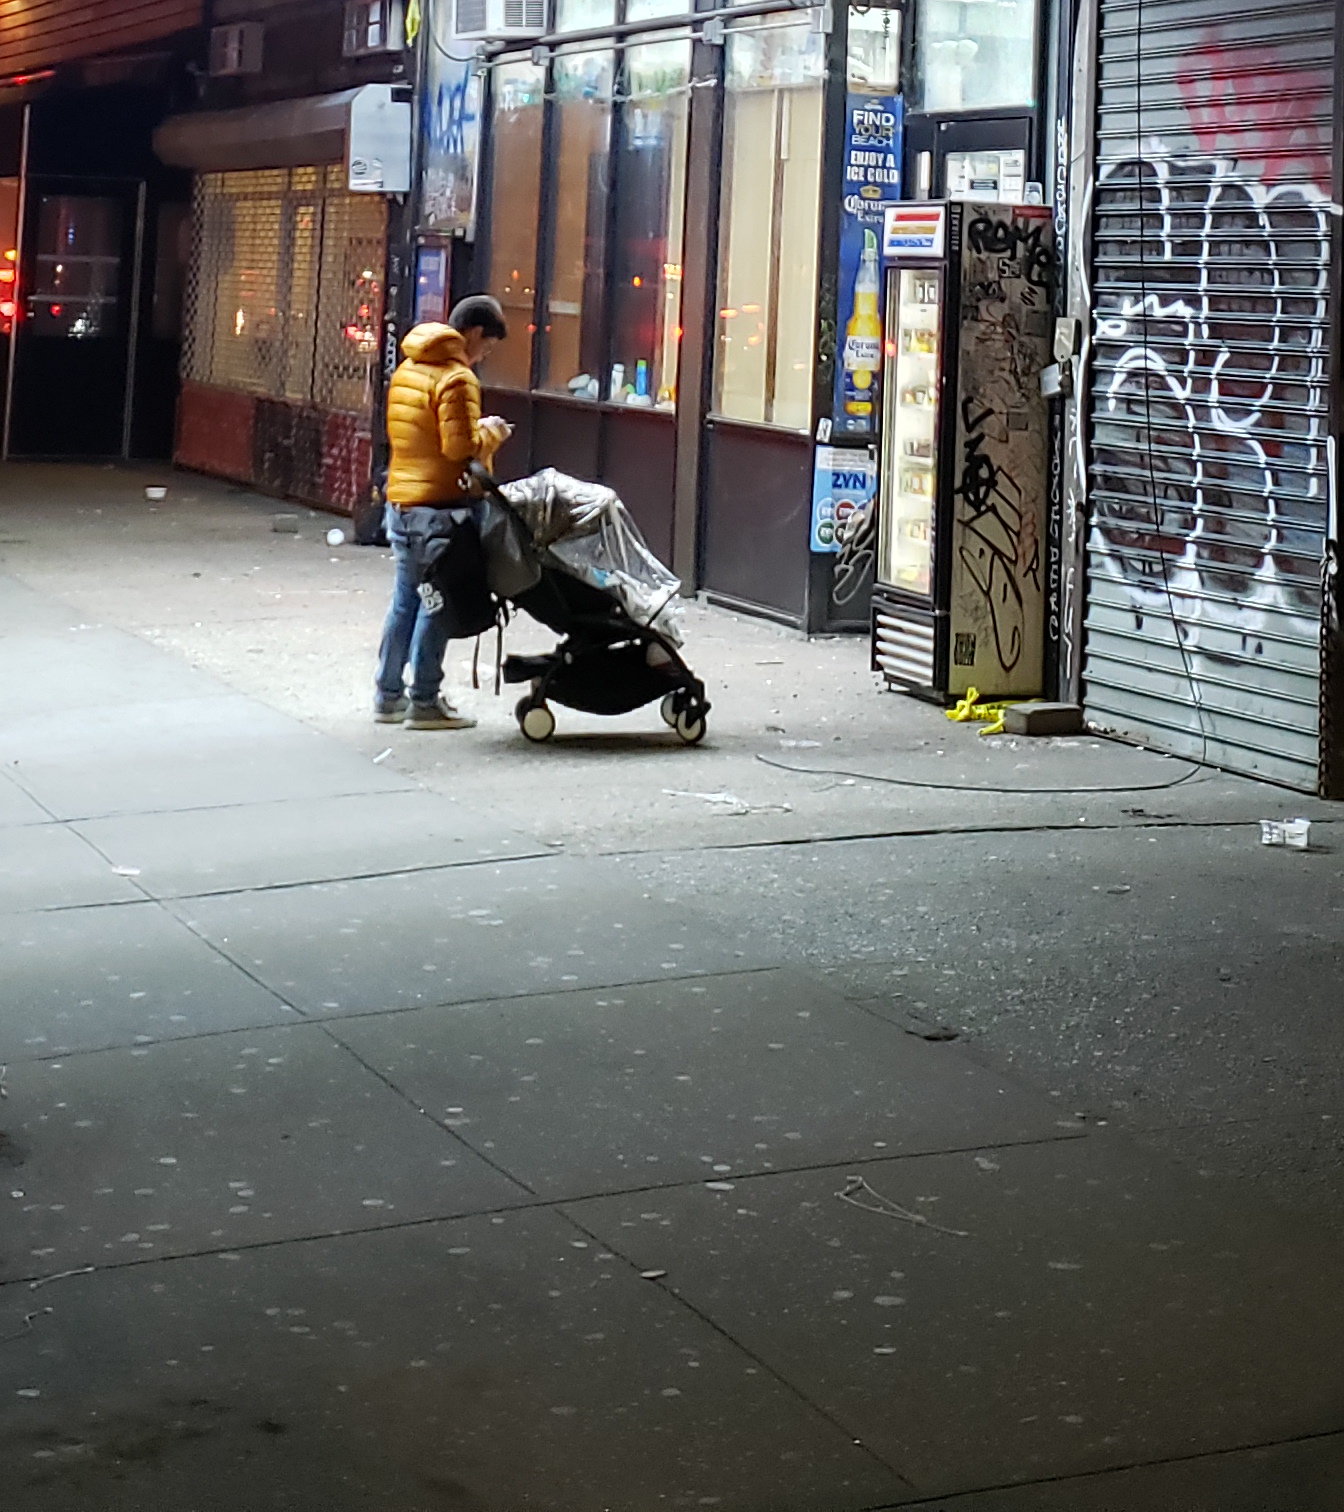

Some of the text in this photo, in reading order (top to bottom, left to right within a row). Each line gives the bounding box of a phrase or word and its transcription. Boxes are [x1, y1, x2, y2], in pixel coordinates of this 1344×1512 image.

[853, 109, 895, 126] FIND
[855, 124, 894, 138] YOUR
[851, 134, 893, 148] BEACH
[850, 150, 895, 167] ENJOY A
[846, 166, 899, 184] ICE COLD
[844, 194, 885, 214] Coron
[831, 472, 867, 489] ZYN
